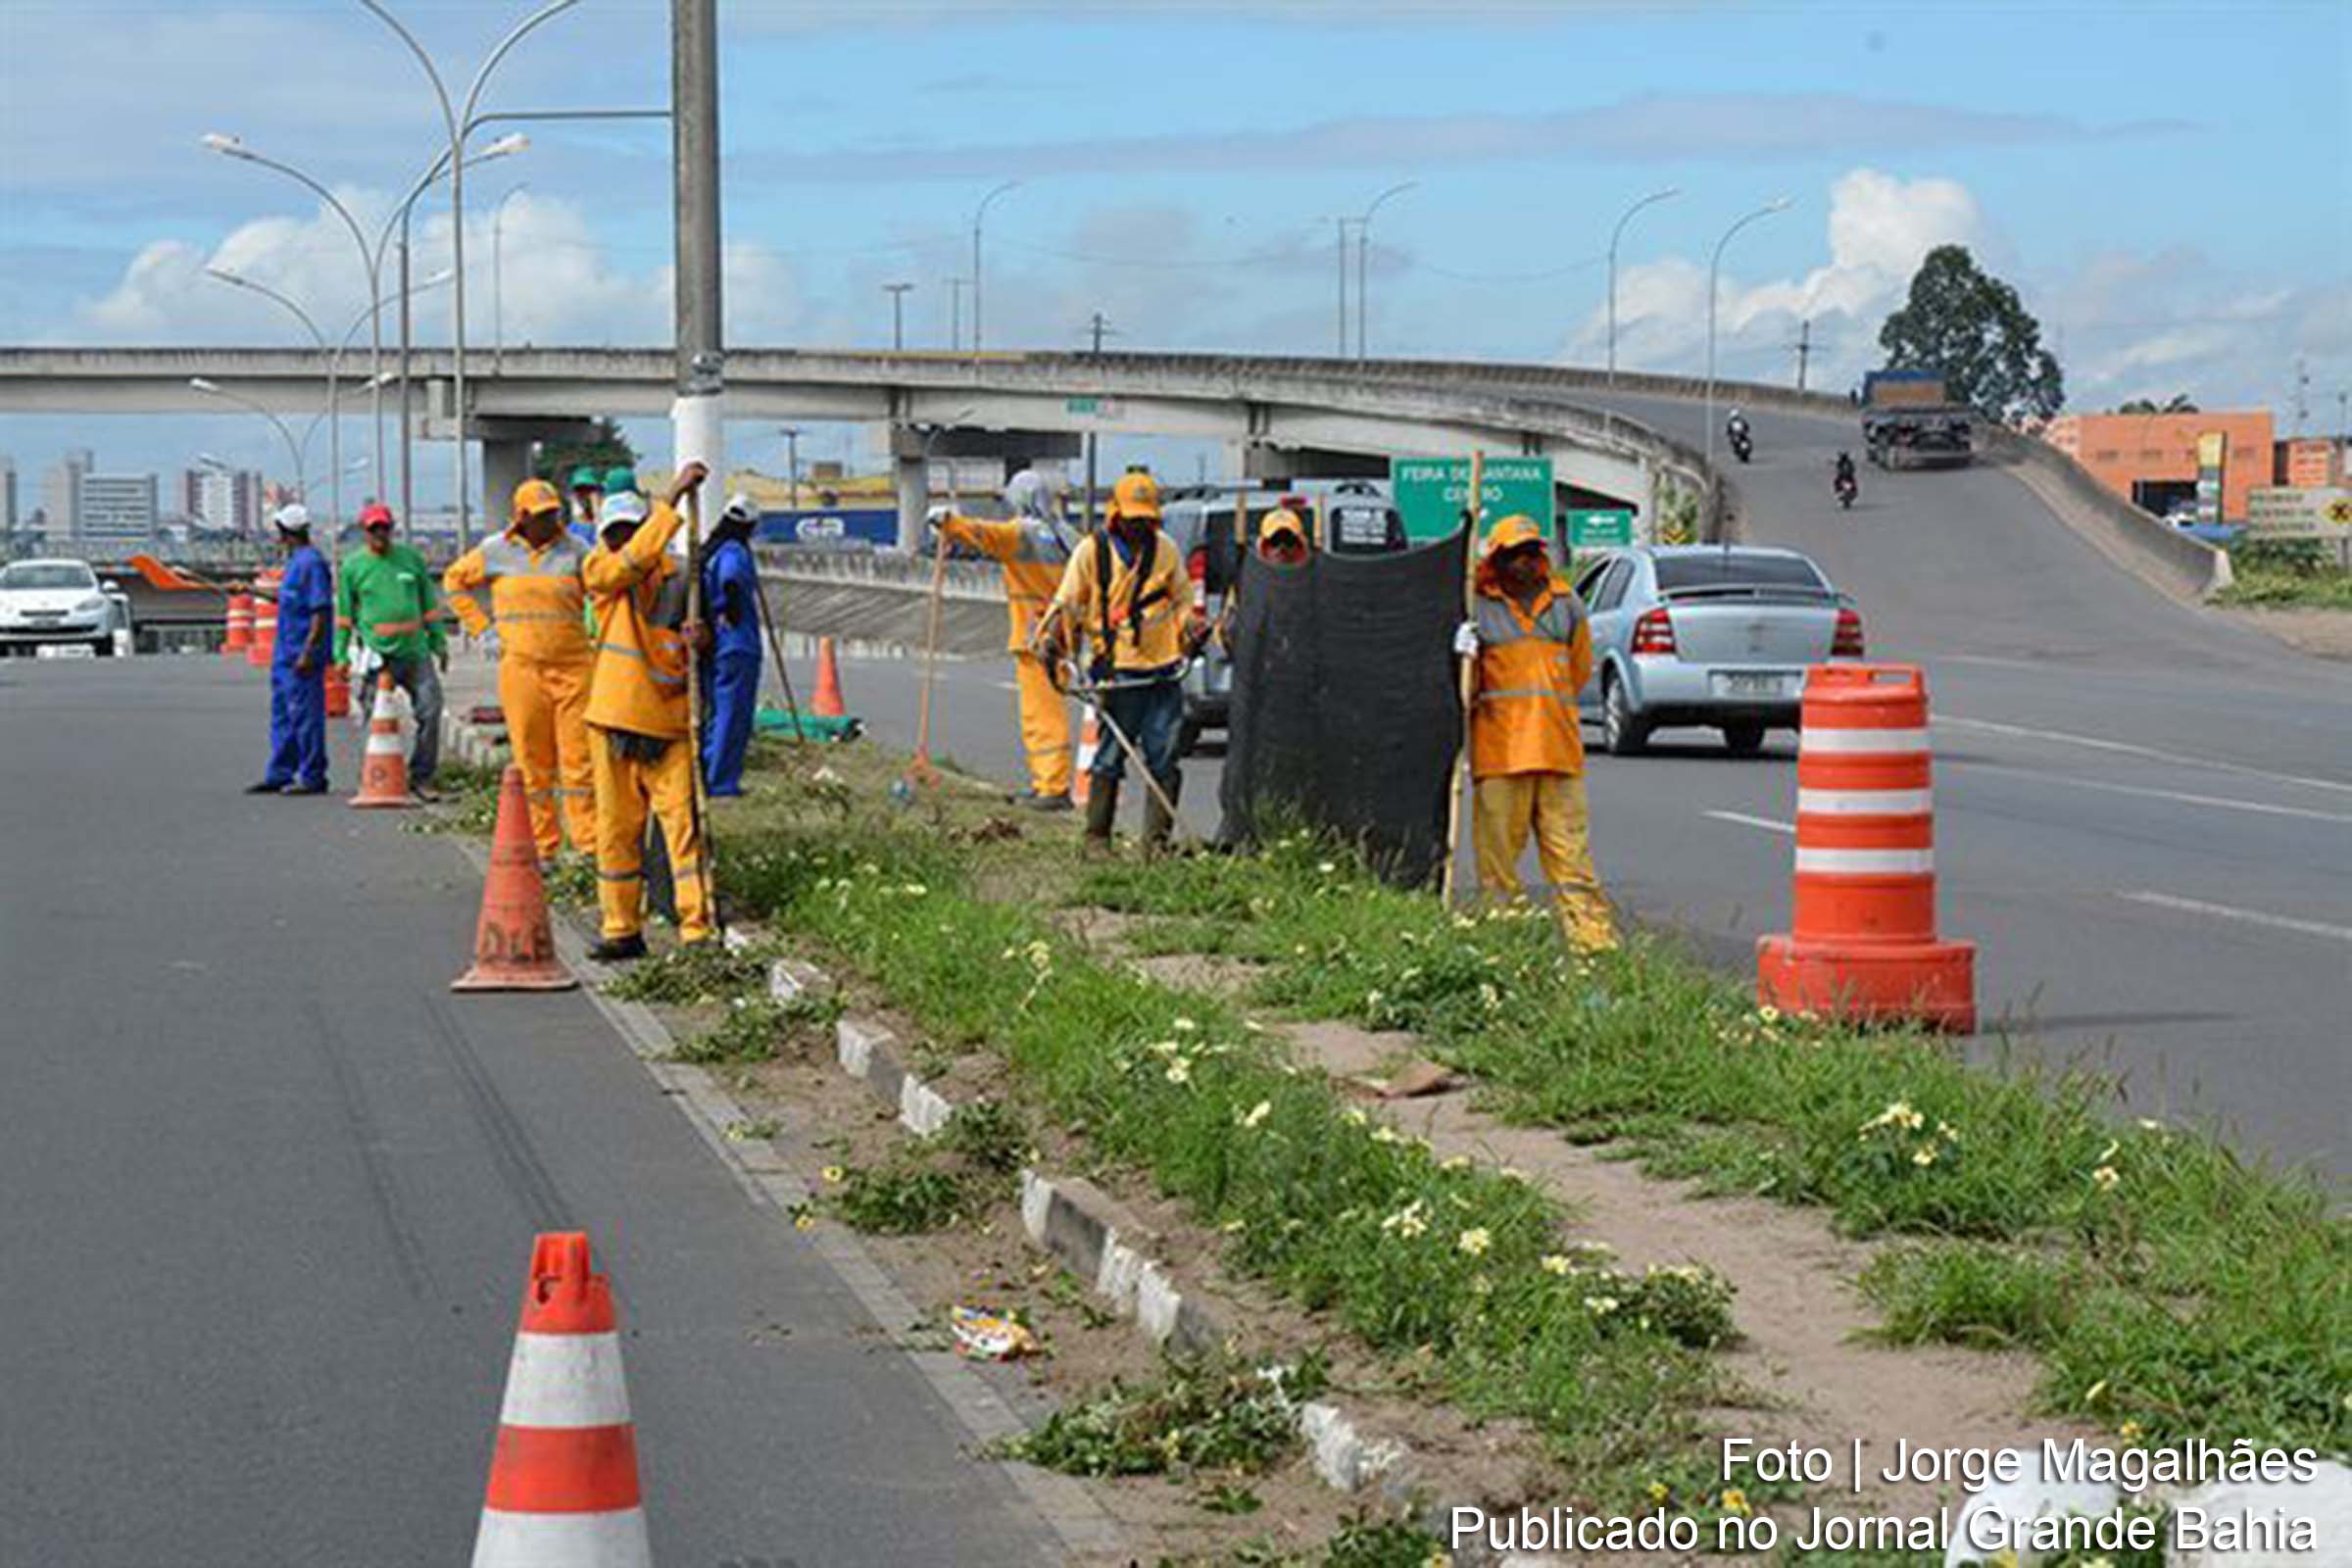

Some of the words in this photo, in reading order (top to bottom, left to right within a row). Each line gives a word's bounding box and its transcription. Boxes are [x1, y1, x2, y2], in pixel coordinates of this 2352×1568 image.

[1400, 466, 1446, 481] FEIRA
[1473, 465, 1543, 481] ANTANA
[1442, 485, 1504, 502] CENRO
